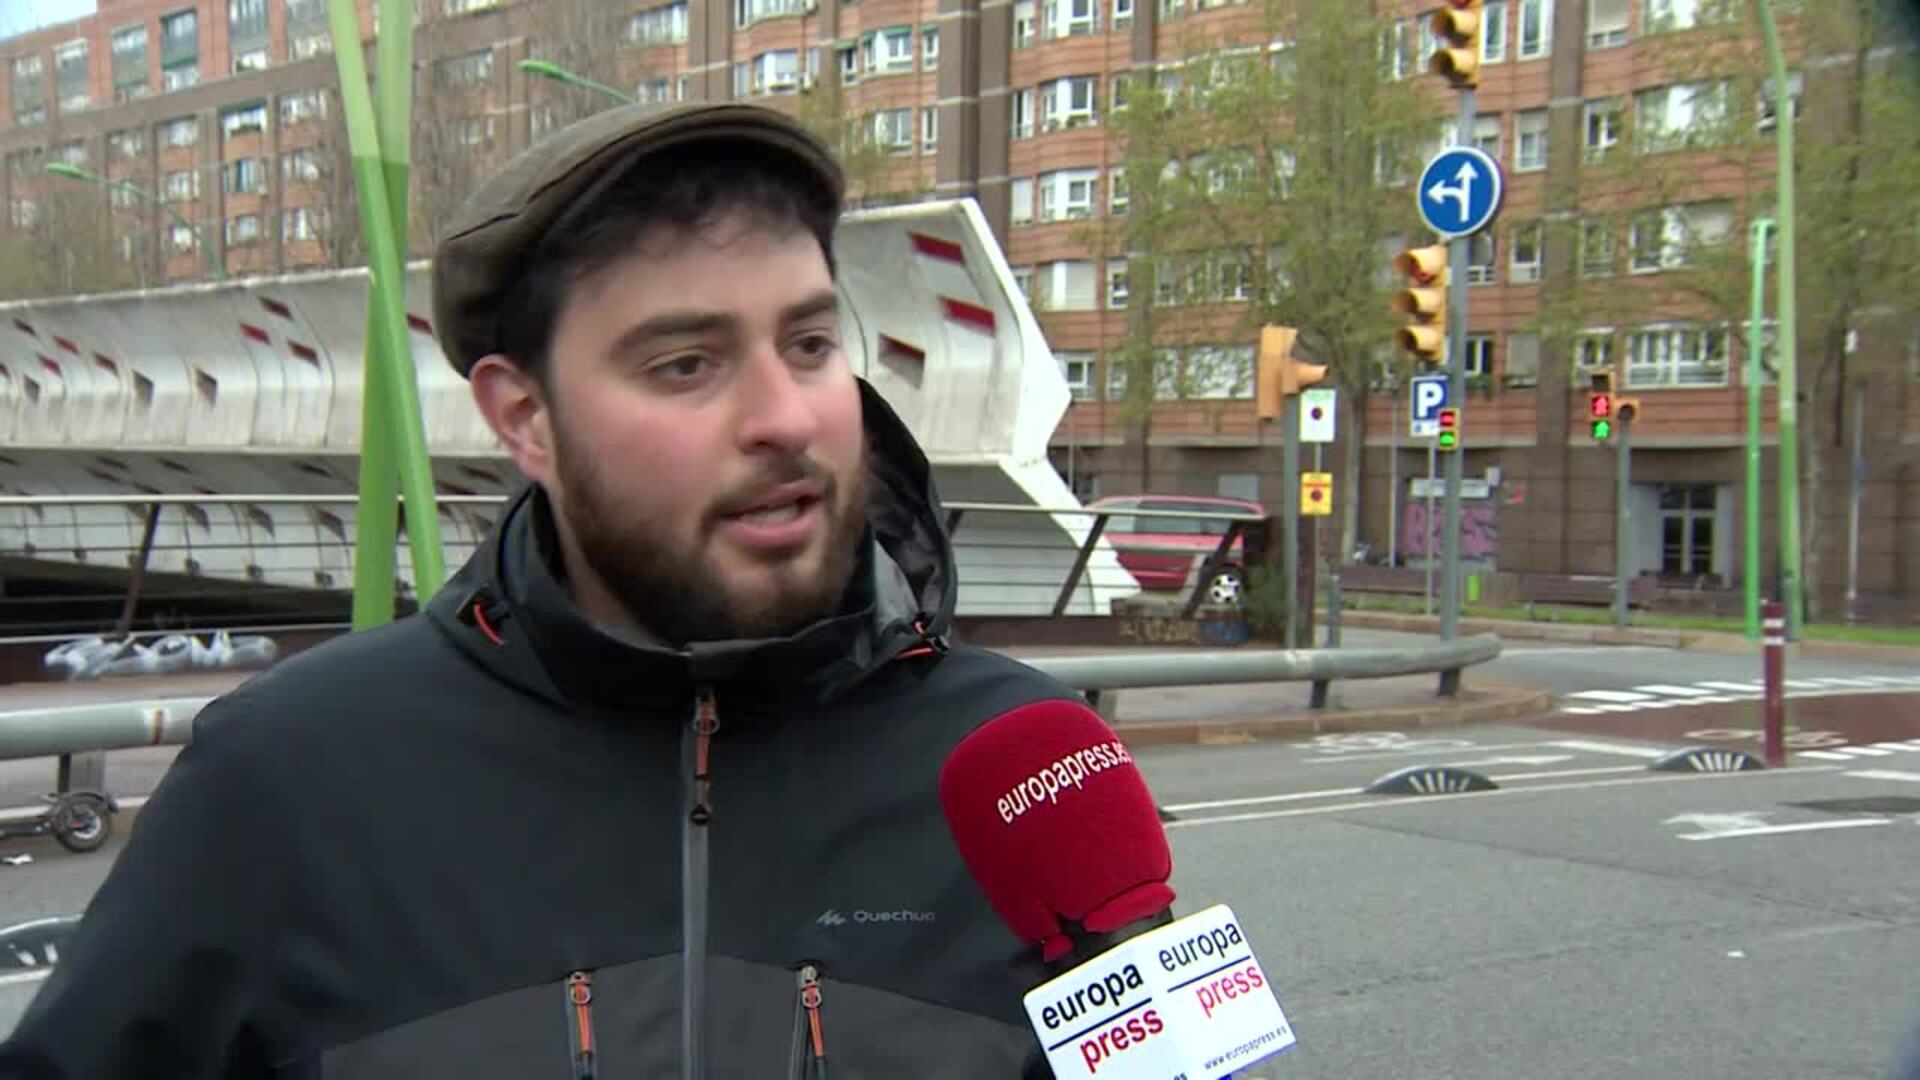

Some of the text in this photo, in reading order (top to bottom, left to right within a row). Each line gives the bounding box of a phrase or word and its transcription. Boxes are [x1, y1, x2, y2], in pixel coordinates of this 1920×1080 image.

[1418, 383, 1443, 417] P
[853, 910, 935, 922] Quechua
[1158, 922, 1243, 972] europa
[1041, 963, 1144, 1029] europa
[1195, 965, 1263, 1018] press
[1079, 1009, 1164, 1073] press
